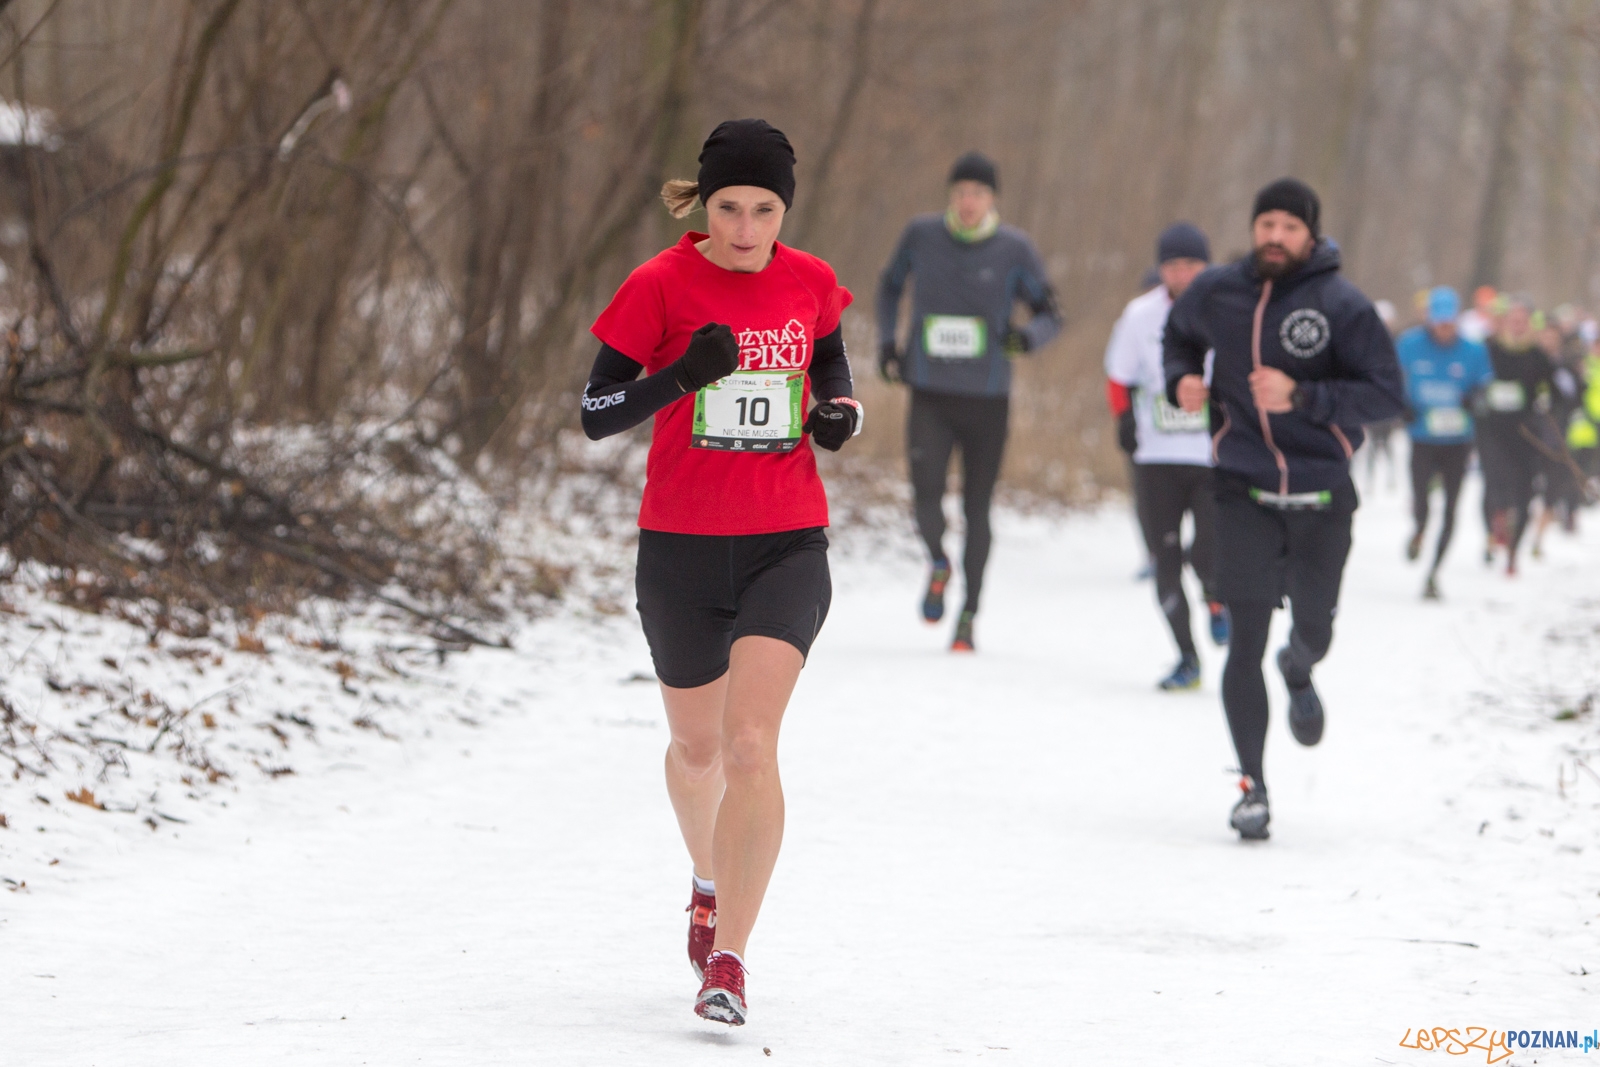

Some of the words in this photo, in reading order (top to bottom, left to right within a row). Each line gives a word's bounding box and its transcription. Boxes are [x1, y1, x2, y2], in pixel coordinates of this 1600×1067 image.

[736, 344, 808, 370] PIKU
[735, 397, 770, 426] 10
[722, 428, 736, 437] NIC
[737, 429, 750, 437] NIE
[751, 429, 778, 438] MUSZE
